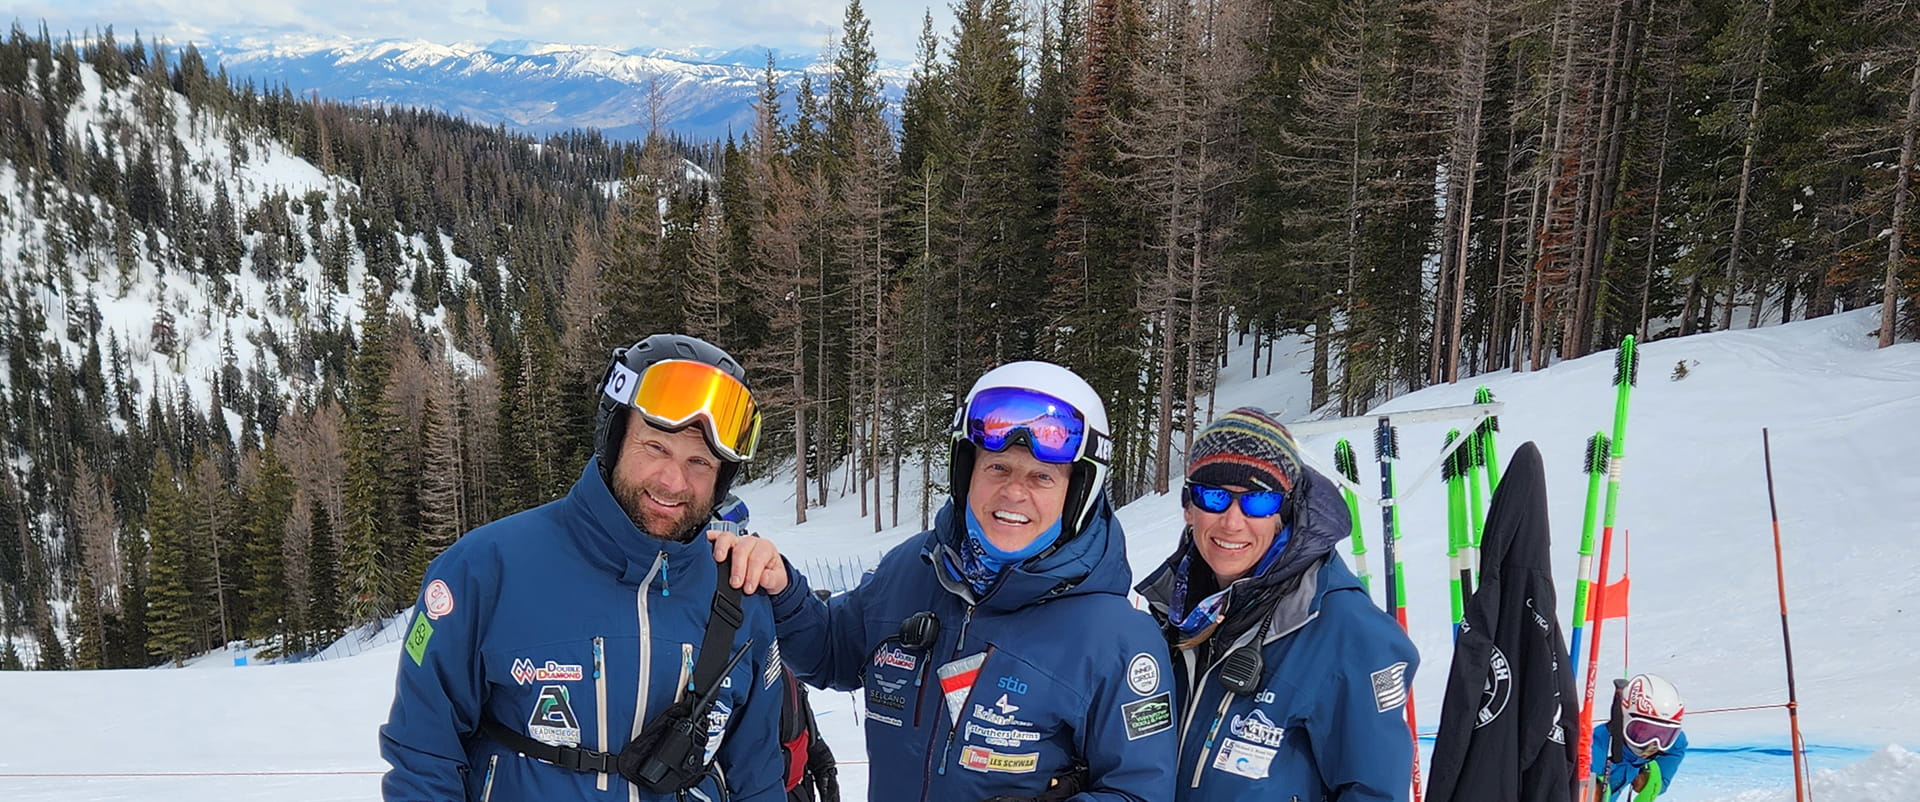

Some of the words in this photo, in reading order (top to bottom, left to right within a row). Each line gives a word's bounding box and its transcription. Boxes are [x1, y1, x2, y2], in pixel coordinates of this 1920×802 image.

[1134, 664, 1152, 675] INNER
[1133, 671, 1155, 683] CIRCLE
[990, 758, 1003, 767] LES
[1004, 758, 1034, 767] SCHWAB
